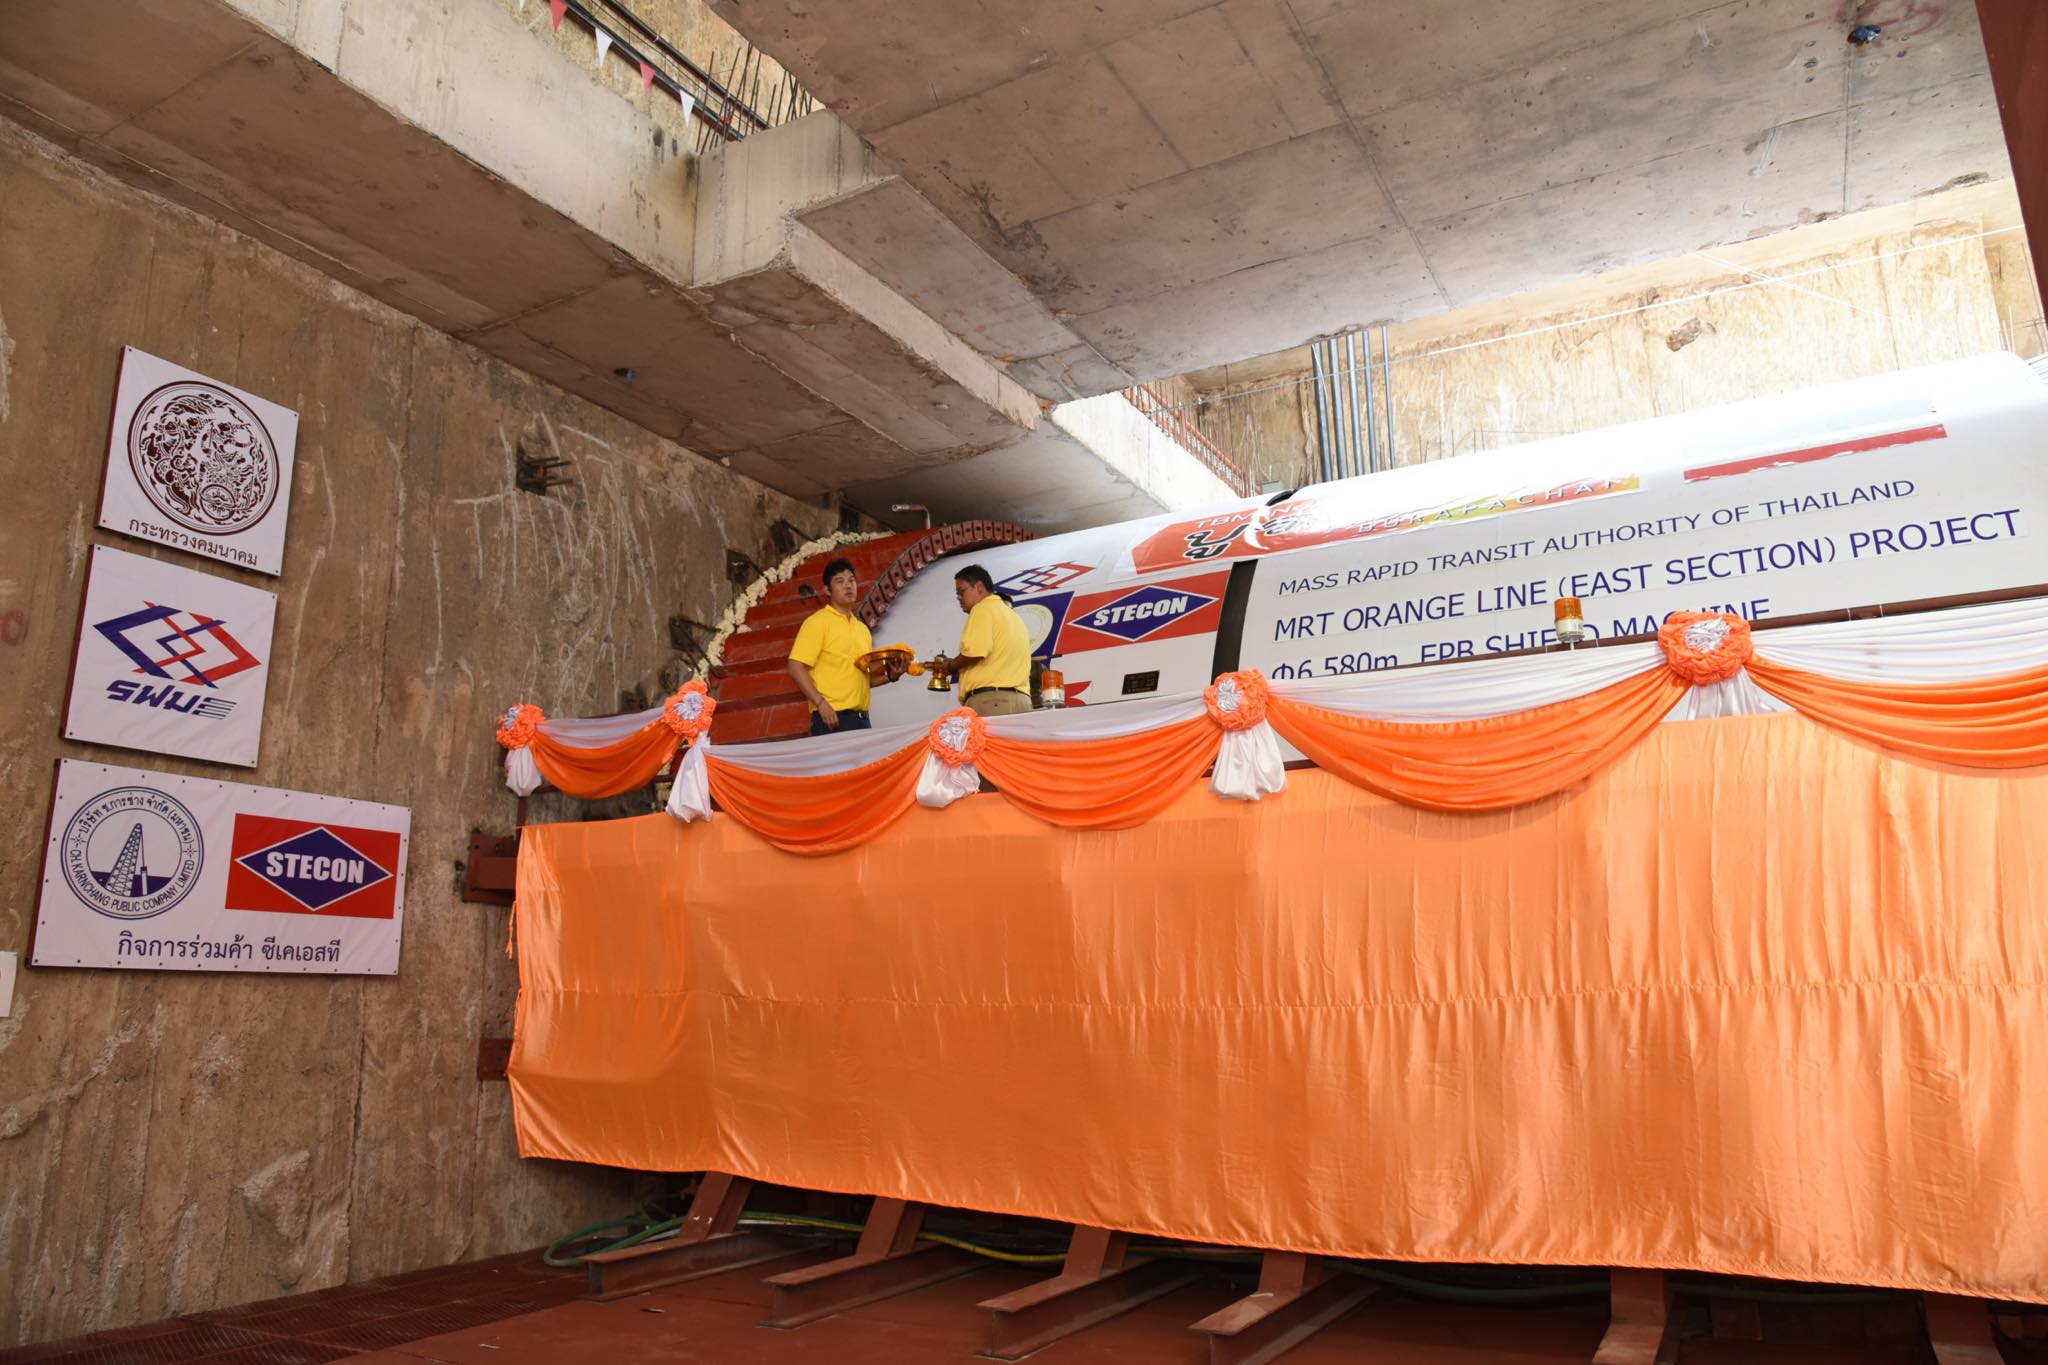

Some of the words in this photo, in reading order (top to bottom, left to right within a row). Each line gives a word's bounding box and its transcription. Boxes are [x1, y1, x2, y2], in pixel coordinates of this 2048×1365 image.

[129, 518, 258, 566] กระทรวงคมนาคม
[1279, 573, 1338, 595] MASS
[1346, 560, 1418, 585] RAPID
[1427, 540, 1535, 571] TRANSIT
[1543, 513, 1701, 554] AUTHORITY
[1712, 505, 1749, 525] OF
[1758, 480, 1914, 518] THAILAND
[1274, 612, 1335, 641] MRT
[1343, 593, 1465, 632] ORANGE
[1477, 580, 1547, 614] LINE
[1558, 563, 1653, 598] (EAST
[1665, 536, 1836, 585] SECTION)
[1850, 508, 2021, 558] PROJECT
[1093, 596, 1188, 626] STECON
[111, 899, 141, 912] PUBLIC
[142, 885, 179, 911] COMPANY
[176, 859, 195, 888] LIMITED
[266, 851, 364, 884] STECON
[118, 931, 253, 960] กิจการร่วมค้า
[262, 936, 341, 962] ซีเคเอสที
